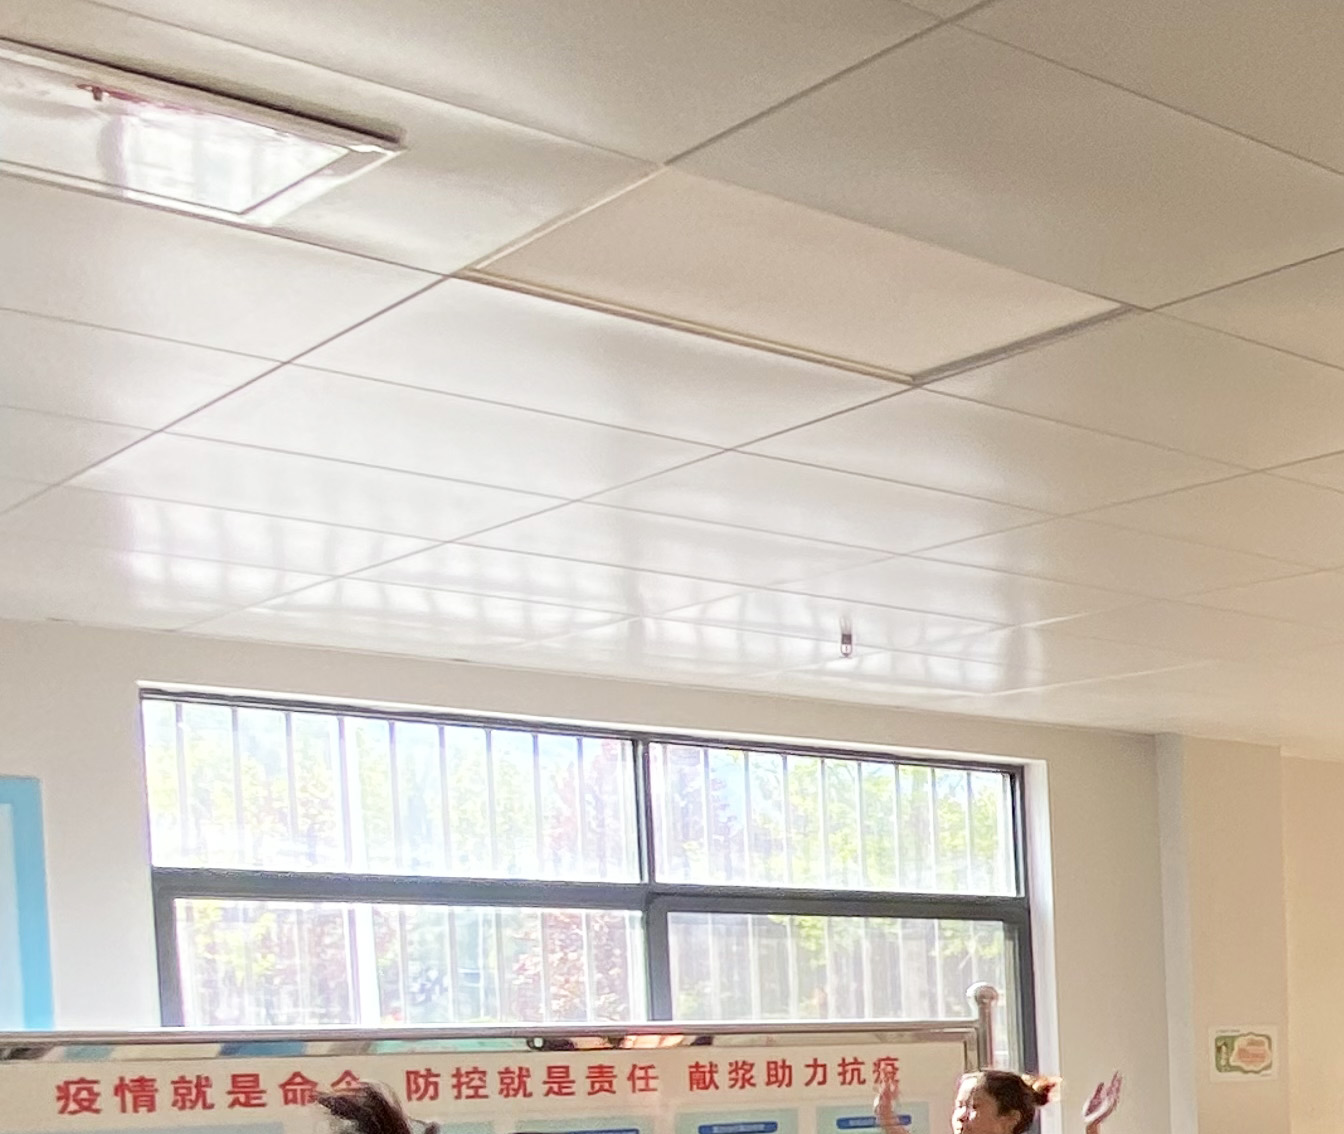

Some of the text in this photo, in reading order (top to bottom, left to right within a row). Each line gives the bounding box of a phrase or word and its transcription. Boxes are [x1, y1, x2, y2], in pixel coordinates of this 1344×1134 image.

[405, 1063, 660, 1102] 防控就是责任
[688, 1056, 900, 1092] 献浆助力抗疫
